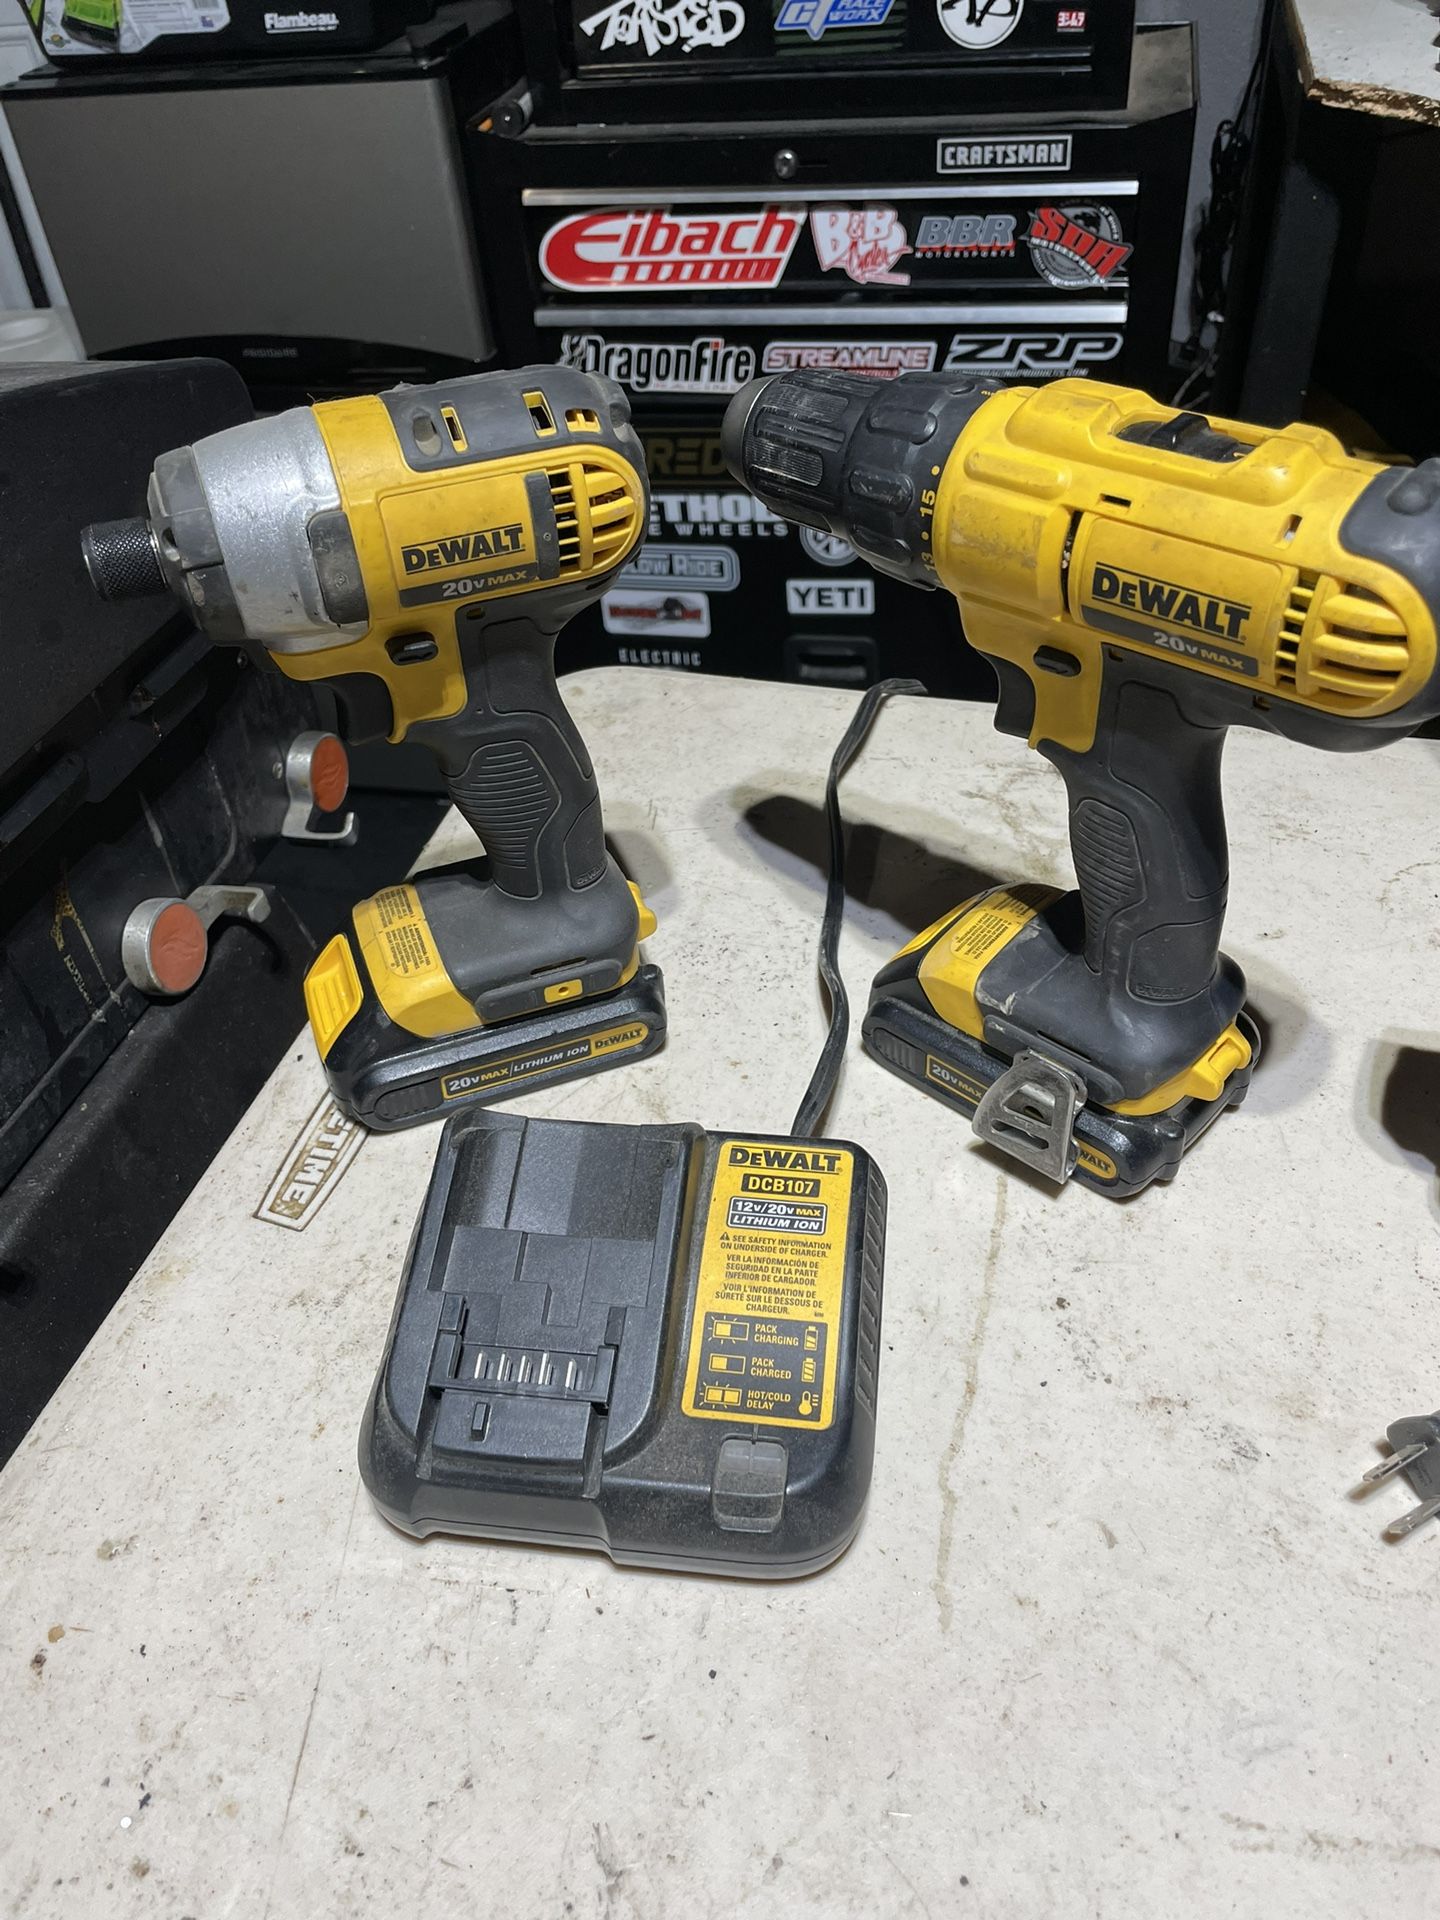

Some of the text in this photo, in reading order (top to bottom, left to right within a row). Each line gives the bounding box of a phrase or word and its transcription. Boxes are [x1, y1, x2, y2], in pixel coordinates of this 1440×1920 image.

[829, 9, 884, 21] WORX
[944, 143, 1065, 167] CRAFTSMAN
[916, 215, 1017, 249] BBR
[541, 204, 805, 290] Eibach
[768, 346, 930, 368] STREAMLINE
[944, 333, 1124, 369] ZRP
[919, 489, 937, 517] 15
[674, 523, 788, 537] WHEELS
[402, 526, 524, 573] DEWALT
[487, 571, 527, 586] MAX
[793, 587, 866, 607] YETI
[1092, 567, 1250, 640] DEWALT
[618, 648, 702, 666] ELECTRIC
[1200, 649, 1246, 671] MAX
[480, 1067, 509, 1082] MAX
[513, 1052, 563, 1072] LITHIUM
[566, 1044, 590, 1059] ION
[595, 1027, 643, 1050] DEWALT
[958, 1080, 983, 1098] MAX
[729, 1148, 841, 1172] DEWALT
[1079, 1148, 1113, 1174] WALT
[748, 1176, 814, 1194] DCB107
[796, 1208, 821, 1217] MAX
[733, 1216, 820, 1230] LITHIUM ION
[733, 1243, 778, 1253] UNDERSIDE
[790, 1248, 828, 1258] CHARGER.
[748, 1236, 776, 1245] SAFETY
[778, 1239, 832, 1250] INFORMATION
[726, 1263, 769, 1274] SEGURIDAD
[794, 1269, 819, 1278] PARTE
[809, 1261, 819, 1269] DE
[725, 1272, 760, 1281] INFERIOR
[723, 1284, 816, 1298] VOIR L'INFORMATION DE
[746, 1294, 762, 1303] SUR
[764, 1295, 773, 1304] LE
[775, 1296, 811, 1307] DESSOUS
[812, 1300, 823, 1309] DE
[746, 1303, 790, 1315] CHARGEUR.
[755, 1323, 778, 1334] PACK
[754, 1333, 799, 1346] CHARGING
[751, 1357, 775, 1368] PACK
[750, 1366, 792, 1380] CHARGED
[748, 1390, 791, 1403] HOT/COLD
[746, 1401, 774, 1411] DELAY
